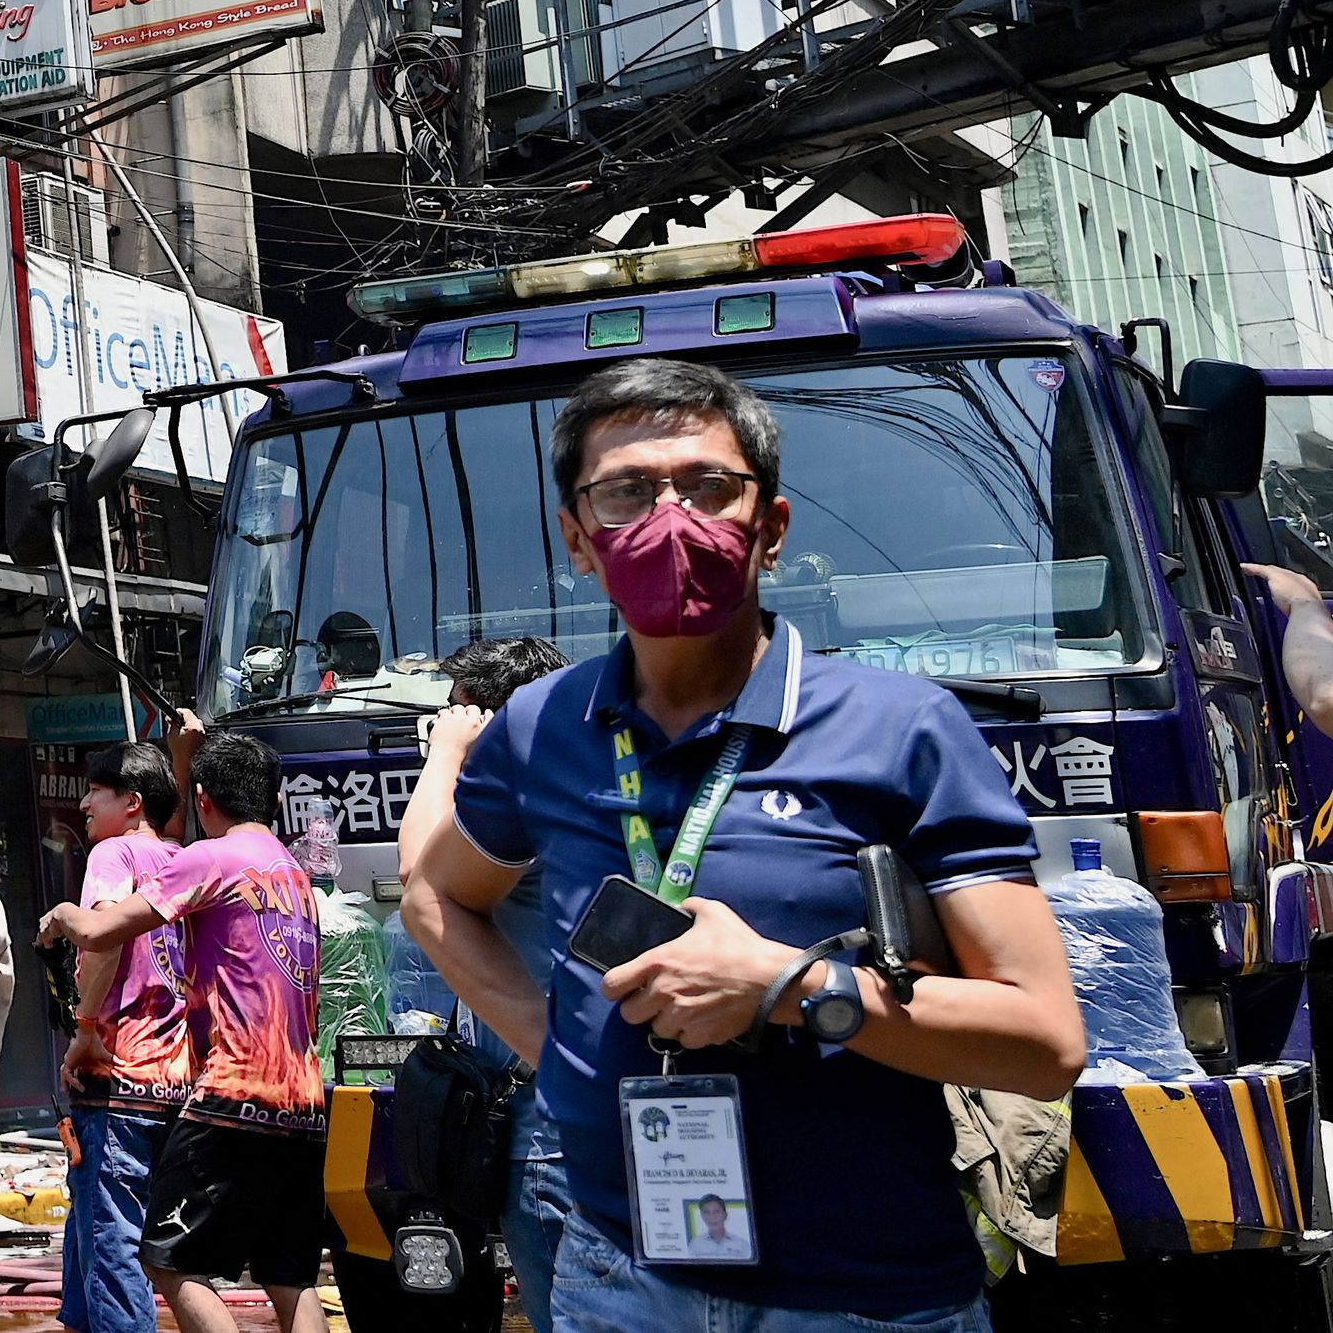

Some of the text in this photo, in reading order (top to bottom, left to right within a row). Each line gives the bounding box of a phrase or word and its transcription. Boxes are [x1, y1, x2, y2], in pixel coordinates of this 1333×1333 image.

[110, 33, 136, 46] The
[139, 26, 175, 41] Hong
[178, 18, 213, 34] Kong
[217, 9, 252, 22] Style
[42, 68, 66, 88] AID
[931, 643, 1001, 676] 976
[271, 736, 1114, 835] 倫洛巴 火會
[678, 782, 727, 856] NATIONAL
[118, 1078, 146, 1097] Do
[151, 1082, 186, 1101] Good
[239, 1102, 269, 1124] Do
[275, 1109, 316, 1130] Good
